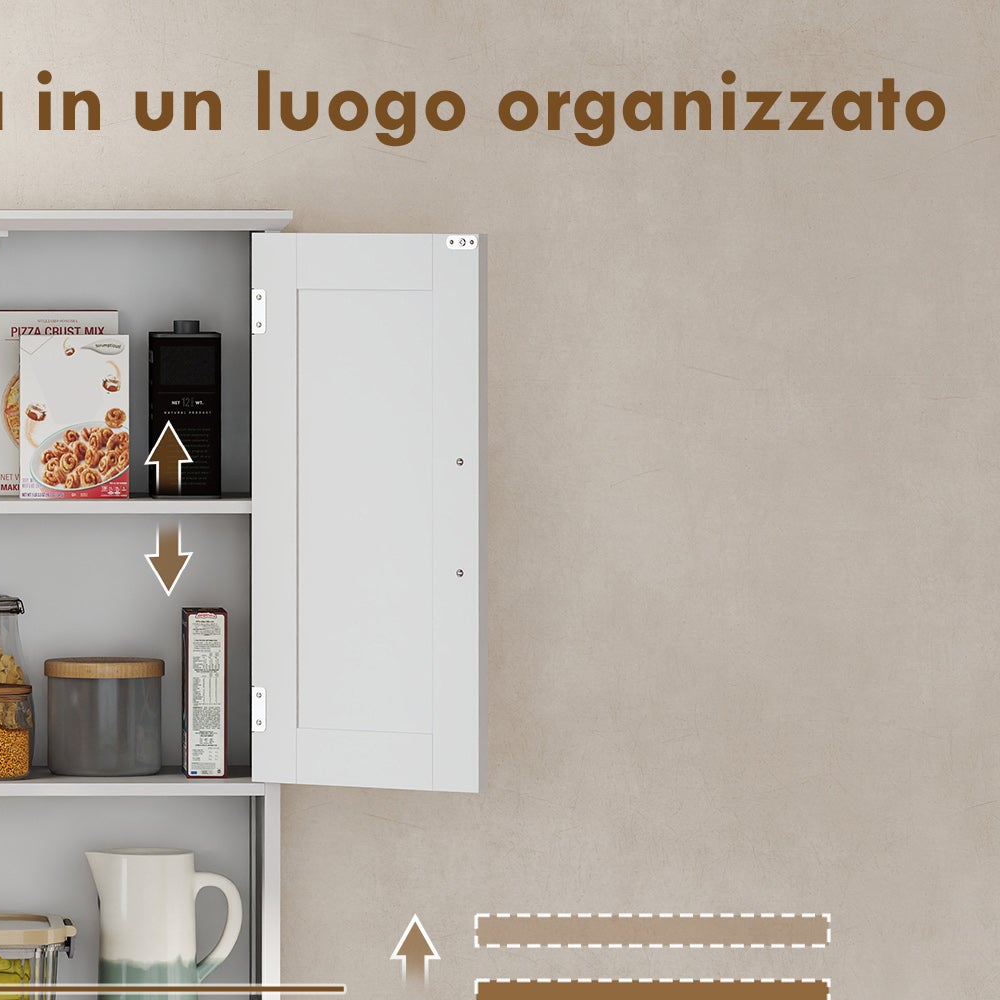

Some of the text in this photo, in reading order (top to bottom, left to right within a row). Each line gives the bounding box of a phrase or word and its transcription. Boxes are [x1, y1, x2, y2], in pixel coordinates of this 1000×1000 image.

[11, 326, 105, 337] PIZZA CRUST MIX
